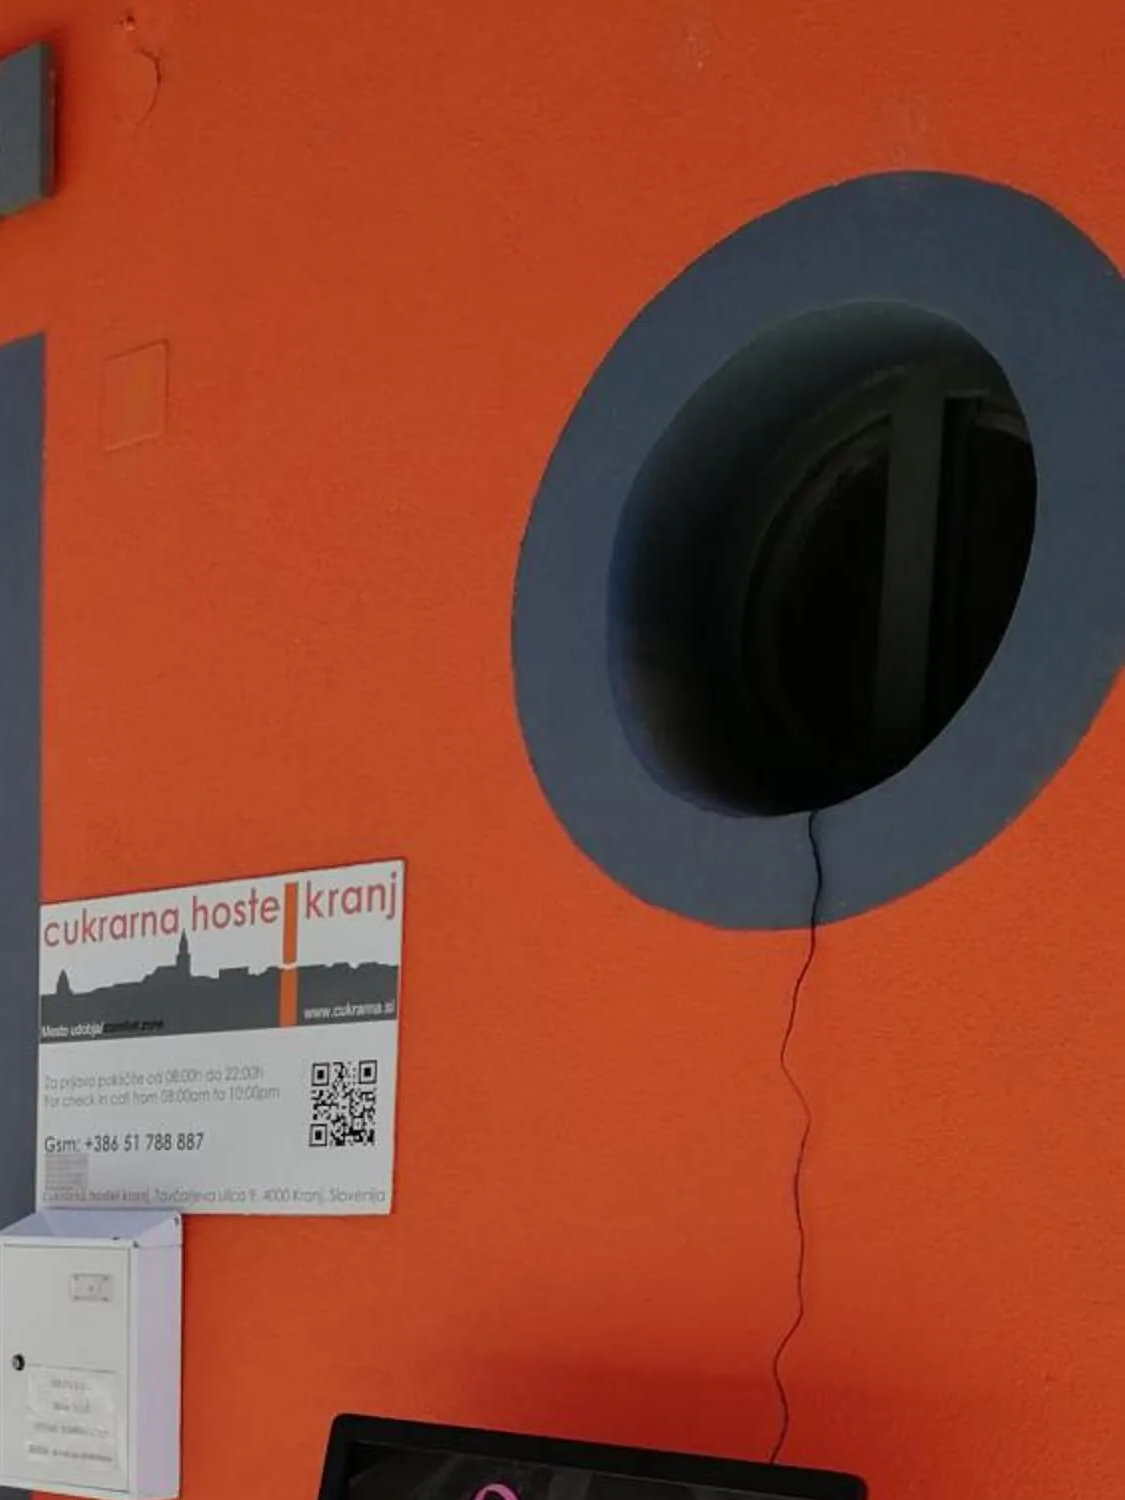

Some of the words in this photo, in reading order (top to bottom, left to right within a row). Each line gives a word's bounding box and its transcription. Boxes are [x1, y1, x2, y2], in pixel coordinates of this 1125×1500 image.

[43, 905, 179, 948] cukrarna
[305, 872, 399, 920] kranj
[44, 1135, 81, 1153] Gsm:
[84, 1134, 120, 1152] +386
[123, 1134, 140, 1151] 51
[145, 1133, 173, 1151] 788
[176, 1132, 205, 1151] 887
